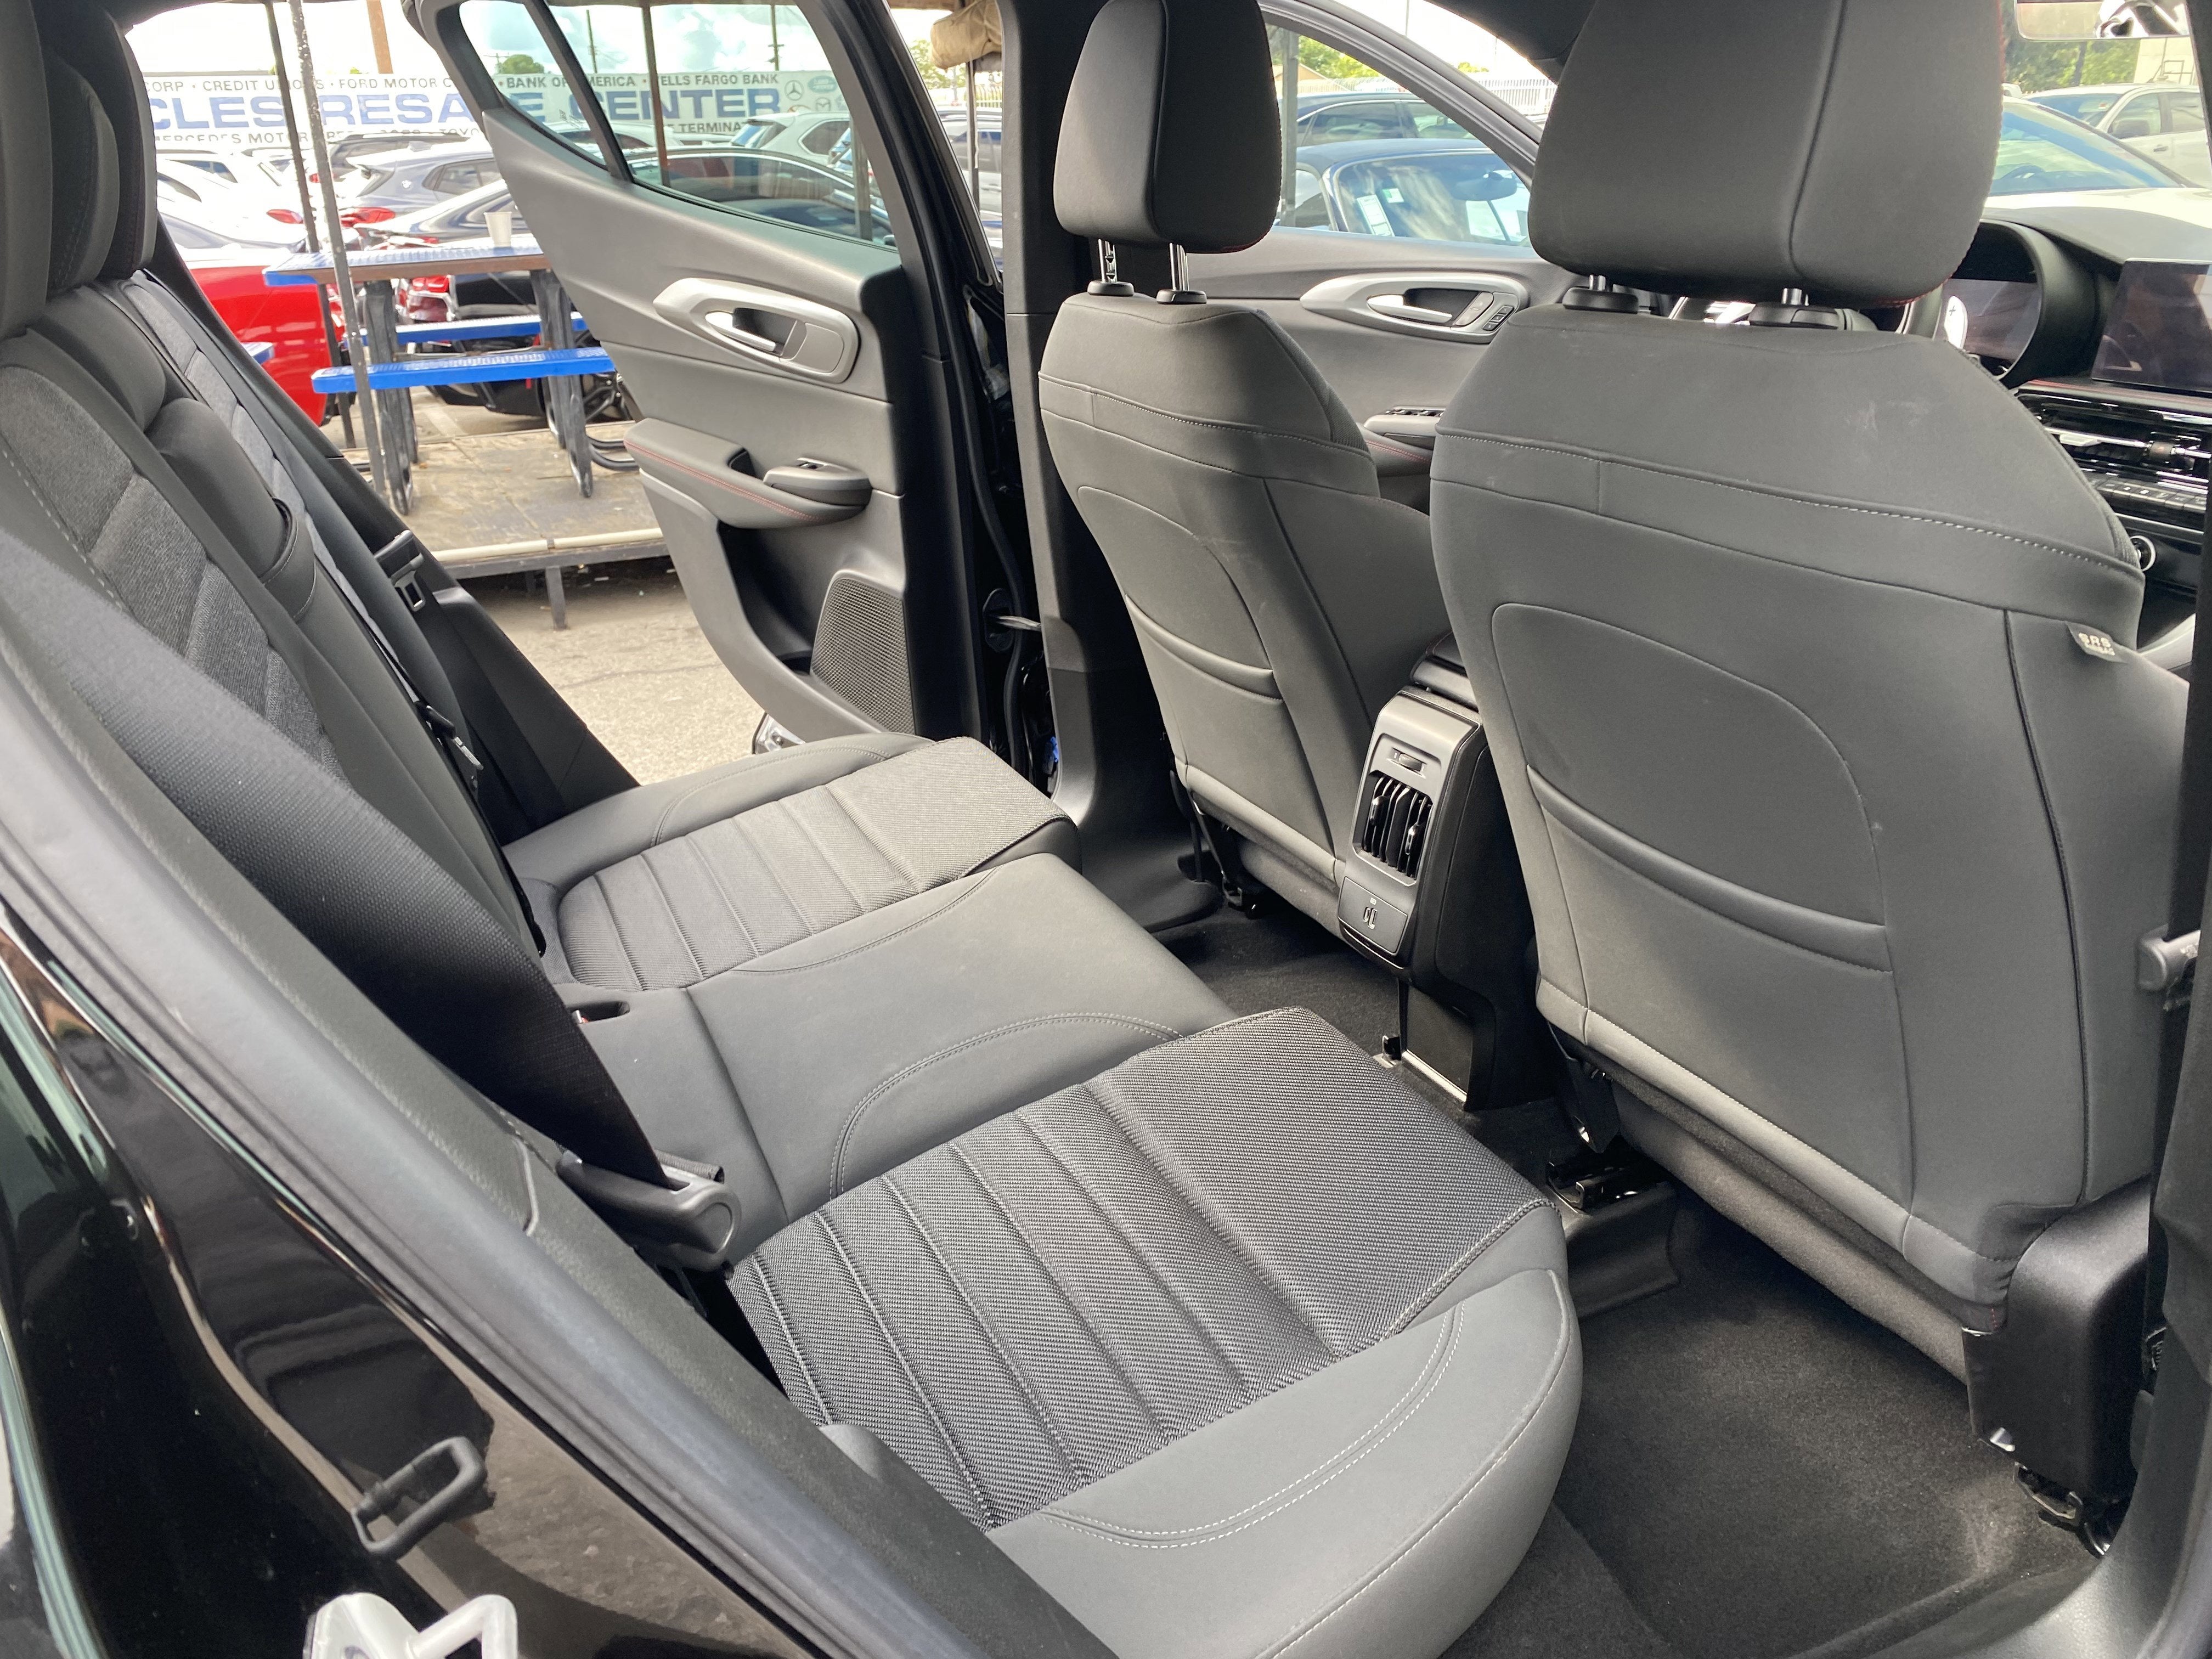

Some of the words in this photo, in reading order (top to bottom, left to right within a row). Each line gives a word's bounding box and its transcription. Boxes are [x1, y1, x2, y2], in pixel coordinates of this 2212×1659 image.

[202, 80, 258, 91] CREDIT
[339, 78, 378, 89] FORD
[385, 78, 437, 88] MOTOR
[506, 76, 546, 88] BANK
[589, 76, 636, 87] MERICA
[658, 75, 691, 86] ELLS
[695, 74, 738, 85] FARGO
[743, 74, 779, 84] BANK
[248, 132, 308, 143] MOTR
[679, 121, 747, 133] TERMINA
